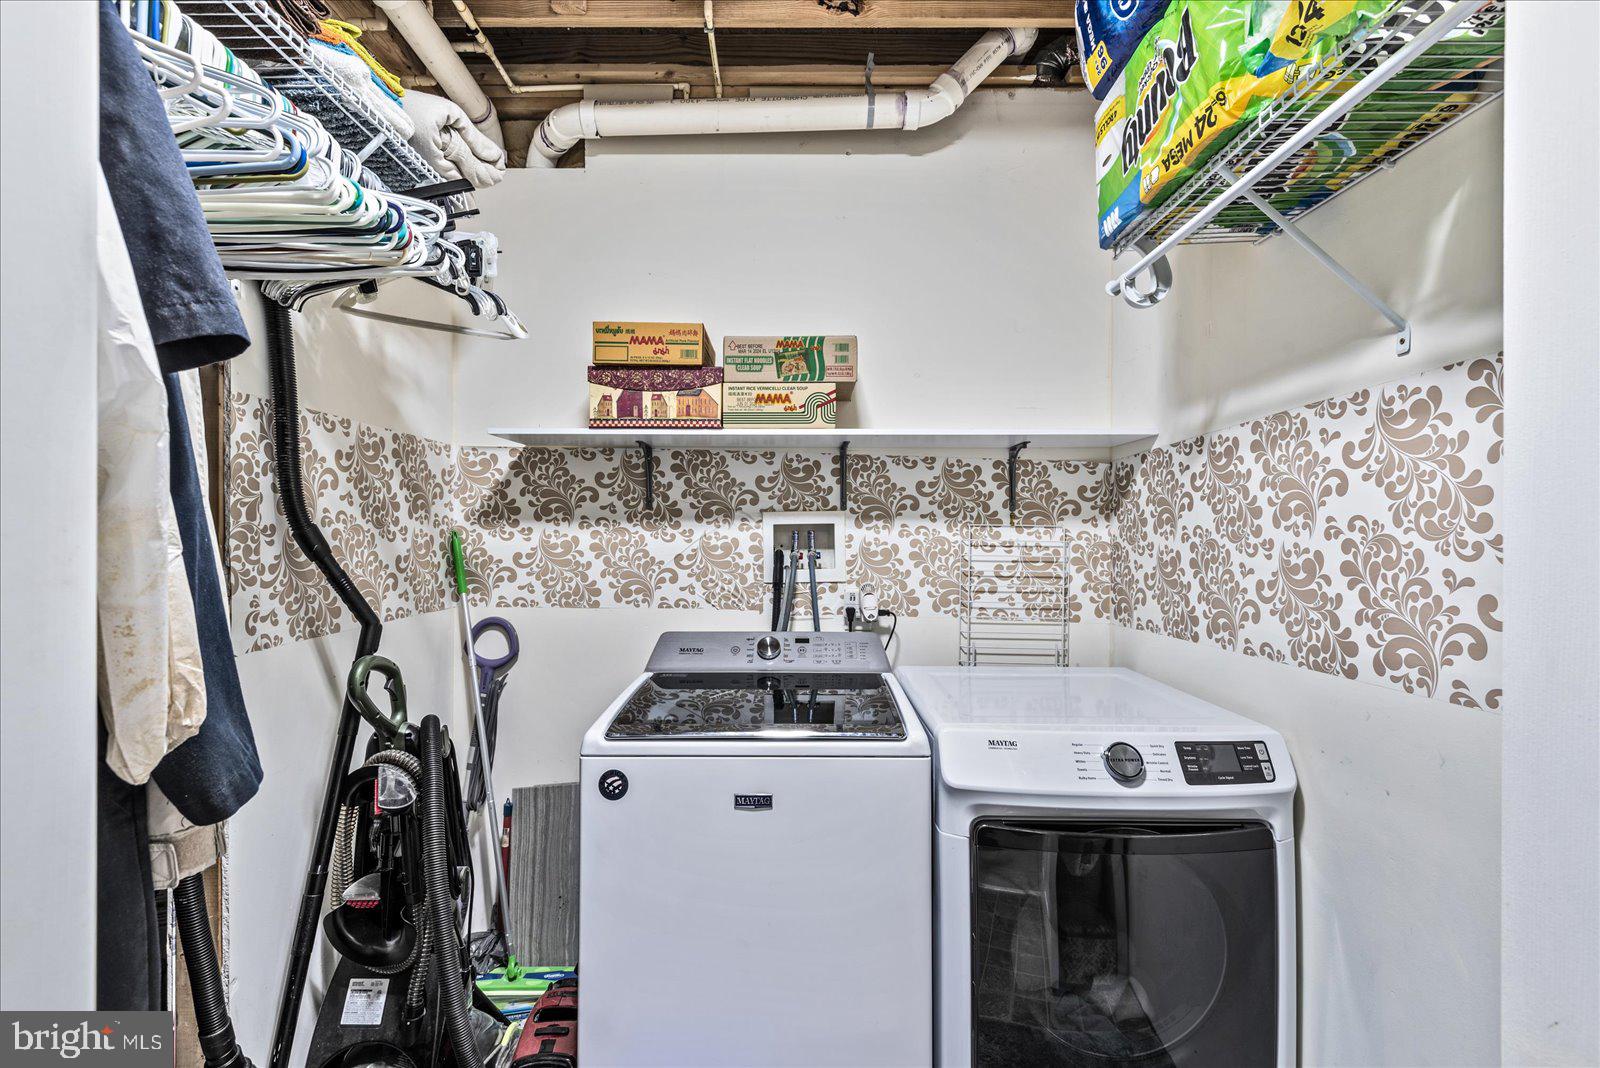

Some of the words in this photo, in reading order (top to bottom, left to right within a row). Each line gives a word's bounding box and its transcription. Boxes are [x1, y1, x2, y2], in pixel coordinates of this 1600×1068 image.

[1121, 5, 1198, 176] Bounty
[1161, 129, 1194, 172] MEGA
[629, 336, 664, 345] MAMA
[775, 340, 804, 348] MAMA
[754, 393, 792, 404] MAMA
[988, 739, 1018, 747] MAYTAG
[736, 797, 770, 805] MAYTAG
